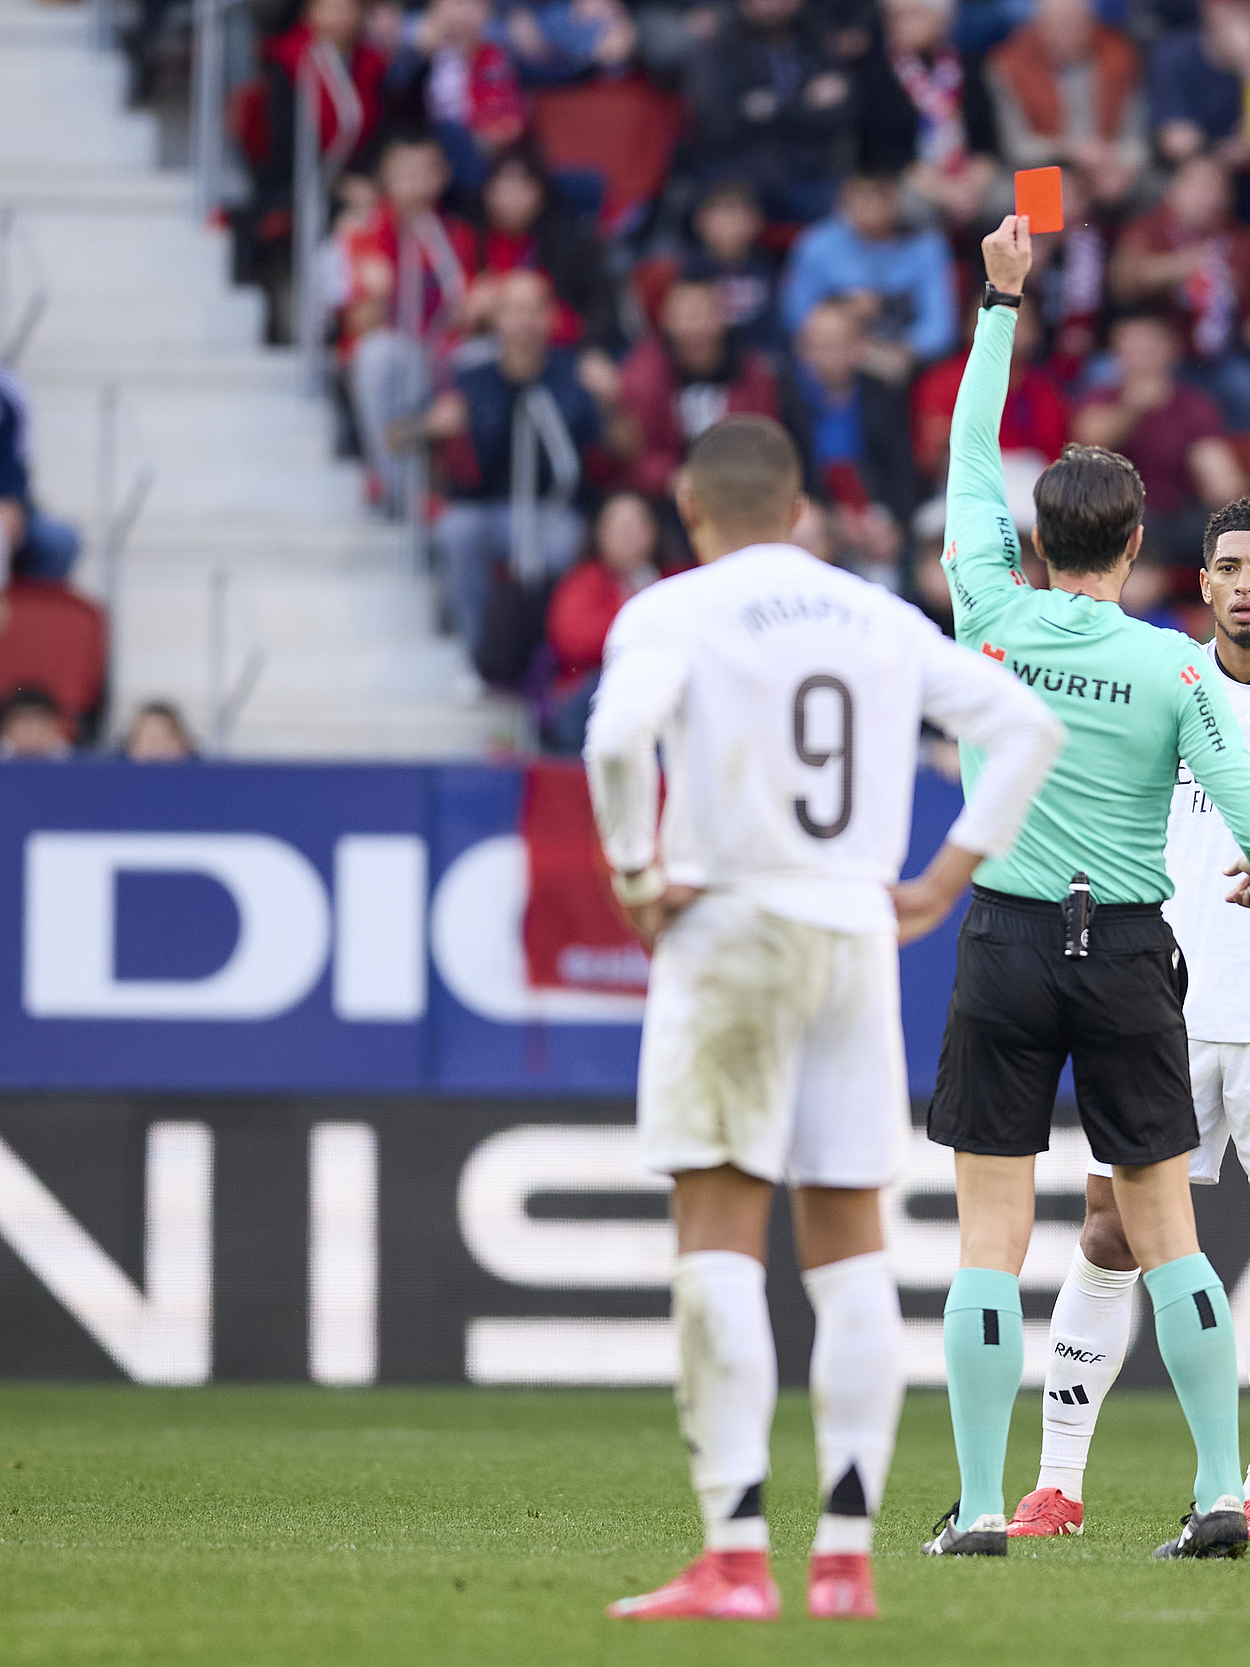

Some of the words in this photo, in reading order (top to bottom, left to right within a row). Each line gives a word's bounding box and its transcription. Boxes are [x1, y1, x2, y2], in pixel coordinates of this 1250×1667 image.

[1012, 659, 1133, 704] WÜRTH
[1193, 685, 1227, 753] WÜRTH
[793, 674, 854, 840] 9
[1191, 790, 1214, 814] FL
[1054, 1341, 1106, 1365] RMCF
